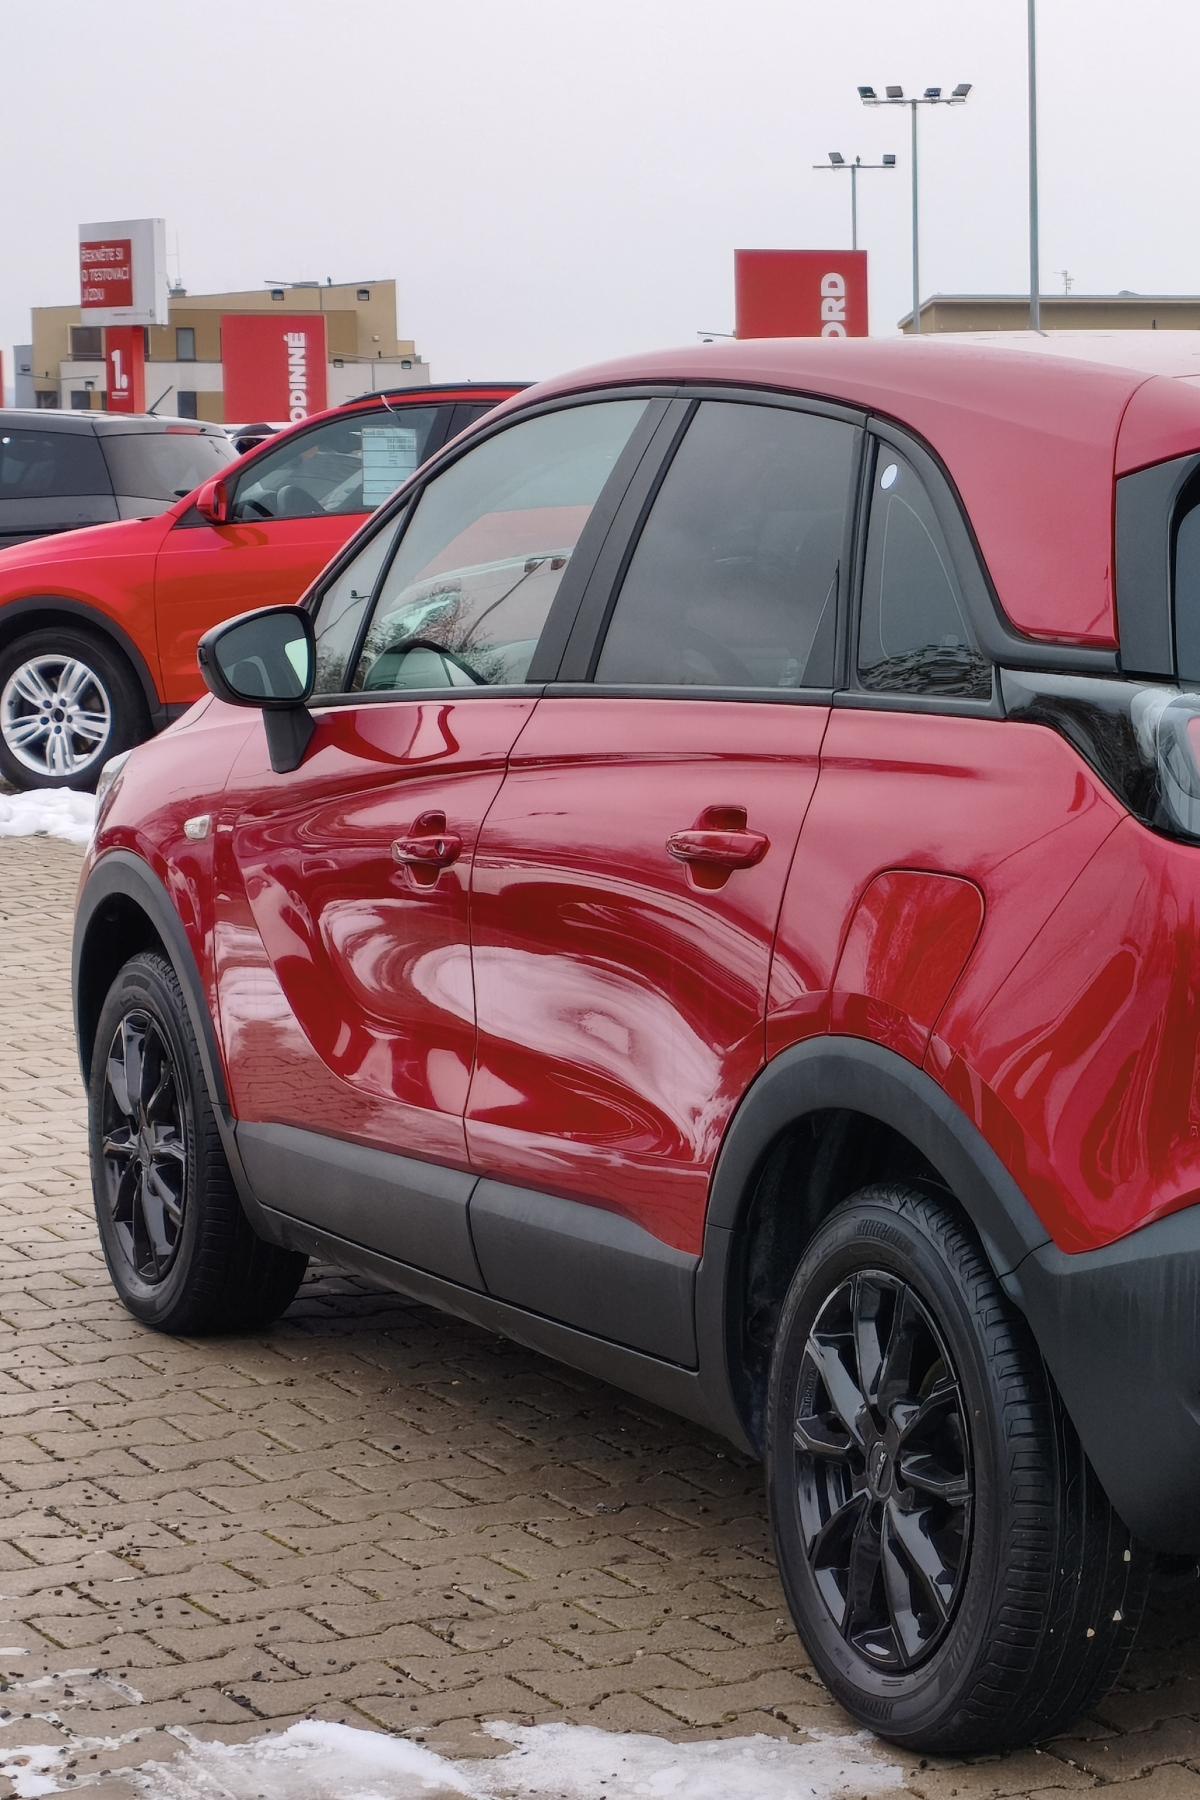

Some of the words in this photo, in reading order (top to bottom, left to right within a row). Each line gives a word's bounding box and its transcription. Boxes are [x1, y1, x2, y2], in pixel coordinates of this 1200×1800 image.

[821, 272, 847, 338] ORD
[111, 349, 128, 389] 1.
[284, 332, 308, 424] ODINNÉ
